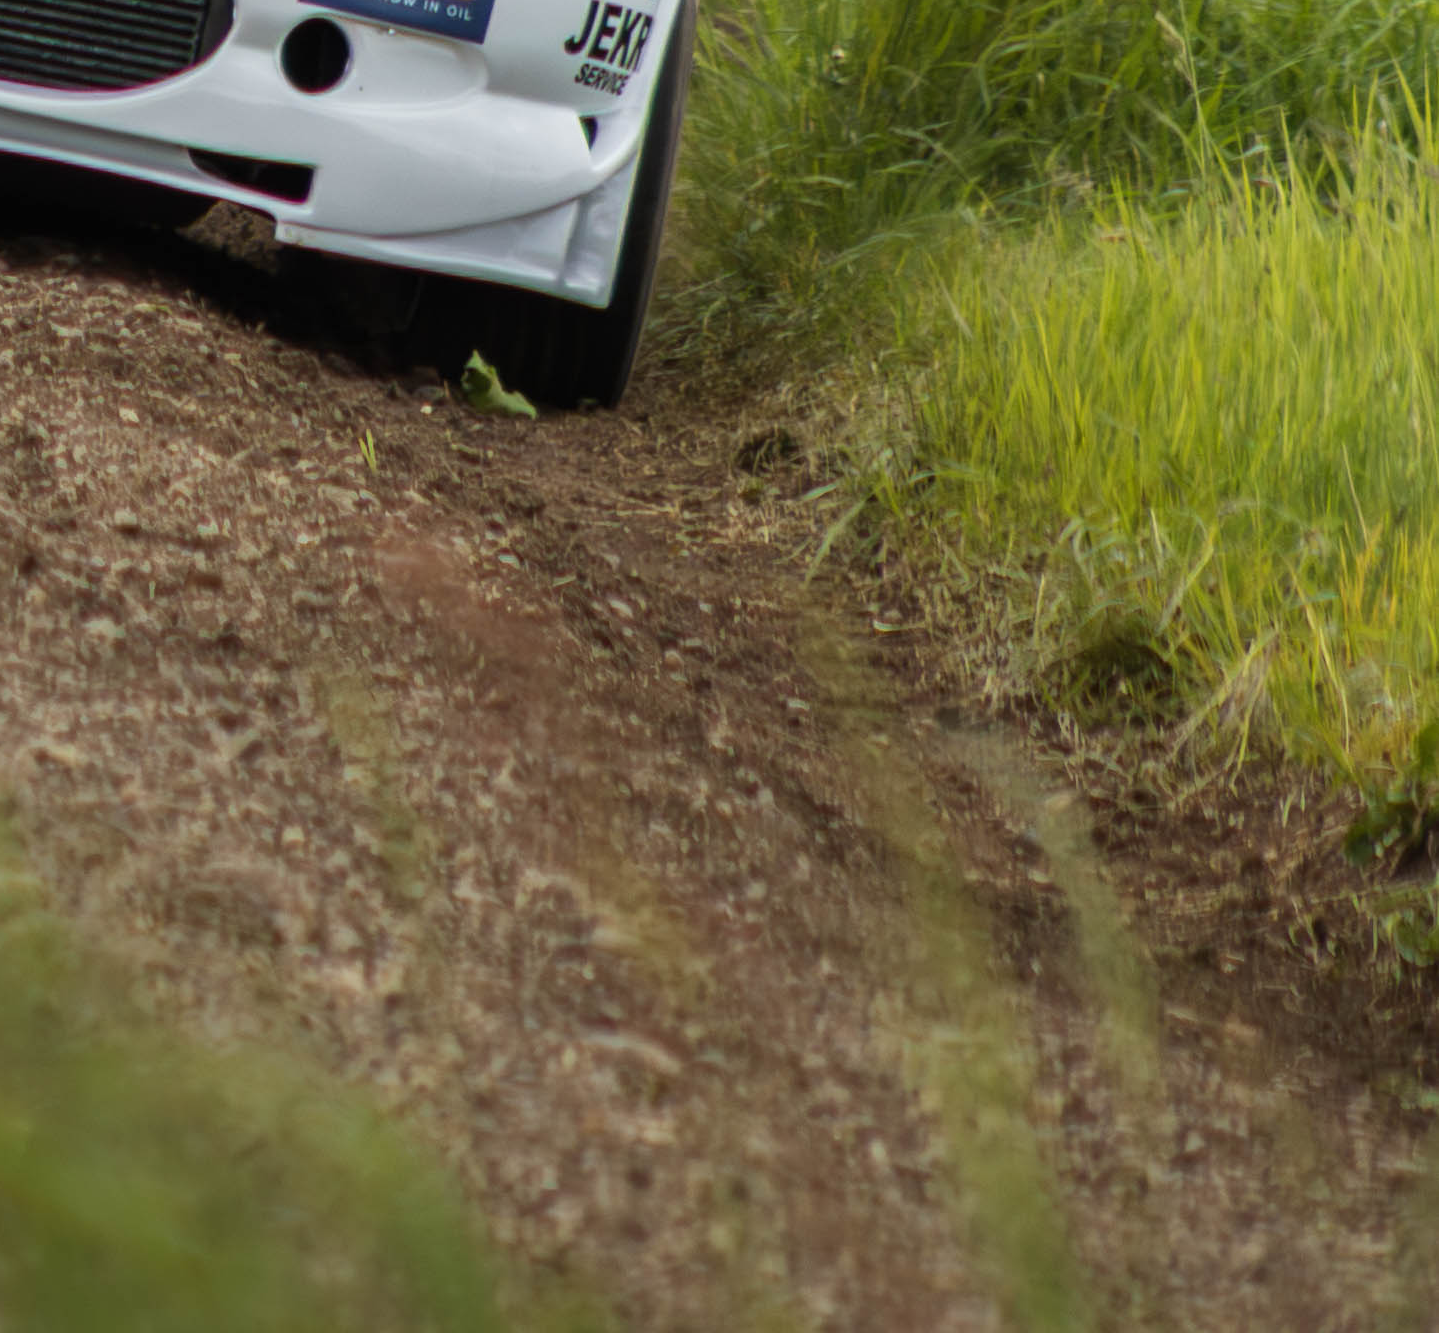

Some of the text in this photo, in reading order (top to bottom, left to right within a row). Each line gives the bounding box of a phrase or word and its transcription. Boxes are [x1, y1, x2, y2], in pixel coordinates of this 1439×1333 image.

[424, 0, 439, 13] IN
[446, 4, 472, 22] OIL
[564, 0, 653, 74] JEKR
